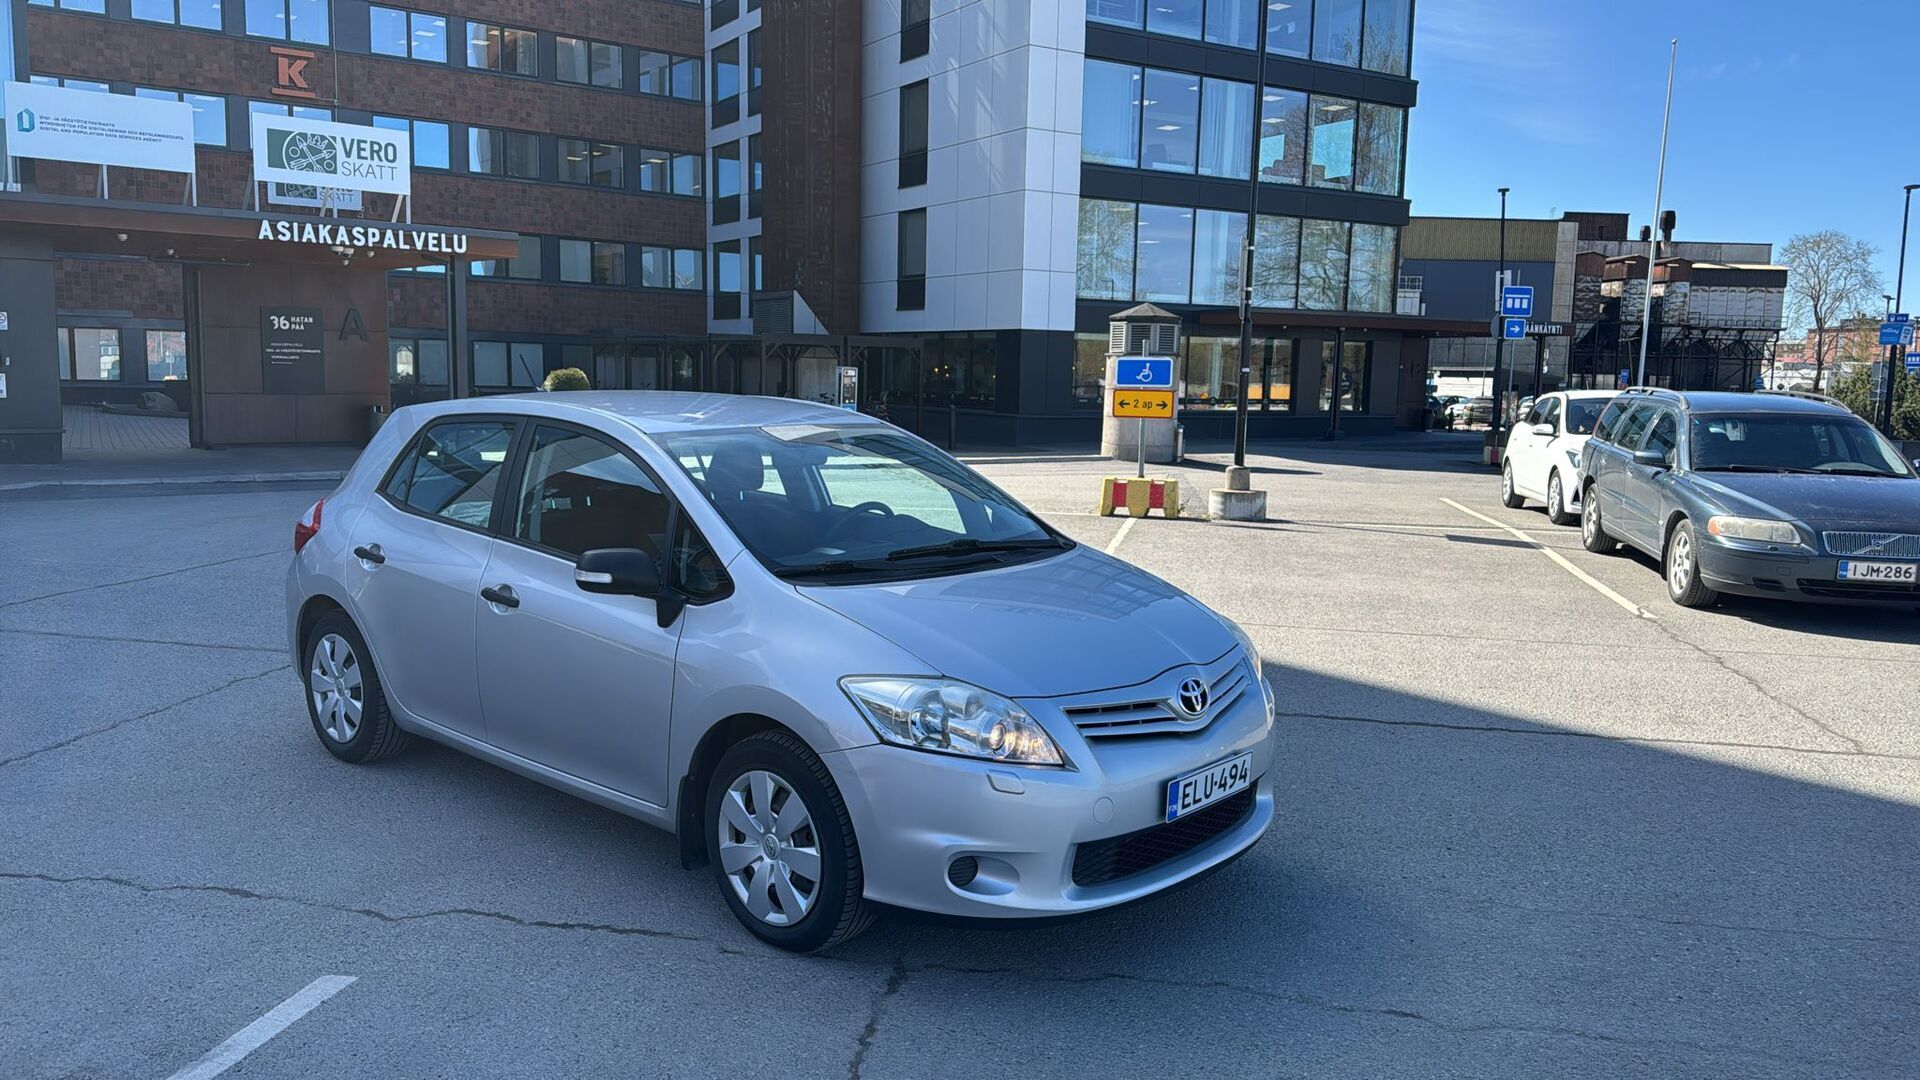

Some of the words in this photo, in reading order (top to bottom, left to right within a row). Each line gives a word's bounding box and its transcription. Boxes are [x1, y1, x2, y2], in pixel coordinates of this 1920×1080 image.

[72, 129, 104, 137] POPULATION
[340, 136, 398, 163] VERO
[341, 161, 398, 181] SKATT
[258, 219, 468, 254] ASIAKASPALVELU
[270, 316, 290, 329] 36
[339, 308, 369, 342] A
[1525, 322, 1563, 334] ÄÄNKÄYNTI
[1133, 399, 1140, 409] 2
[1142, 401, 1153, 410] ap
[1182, 760, 1248, 810] ELU-494
